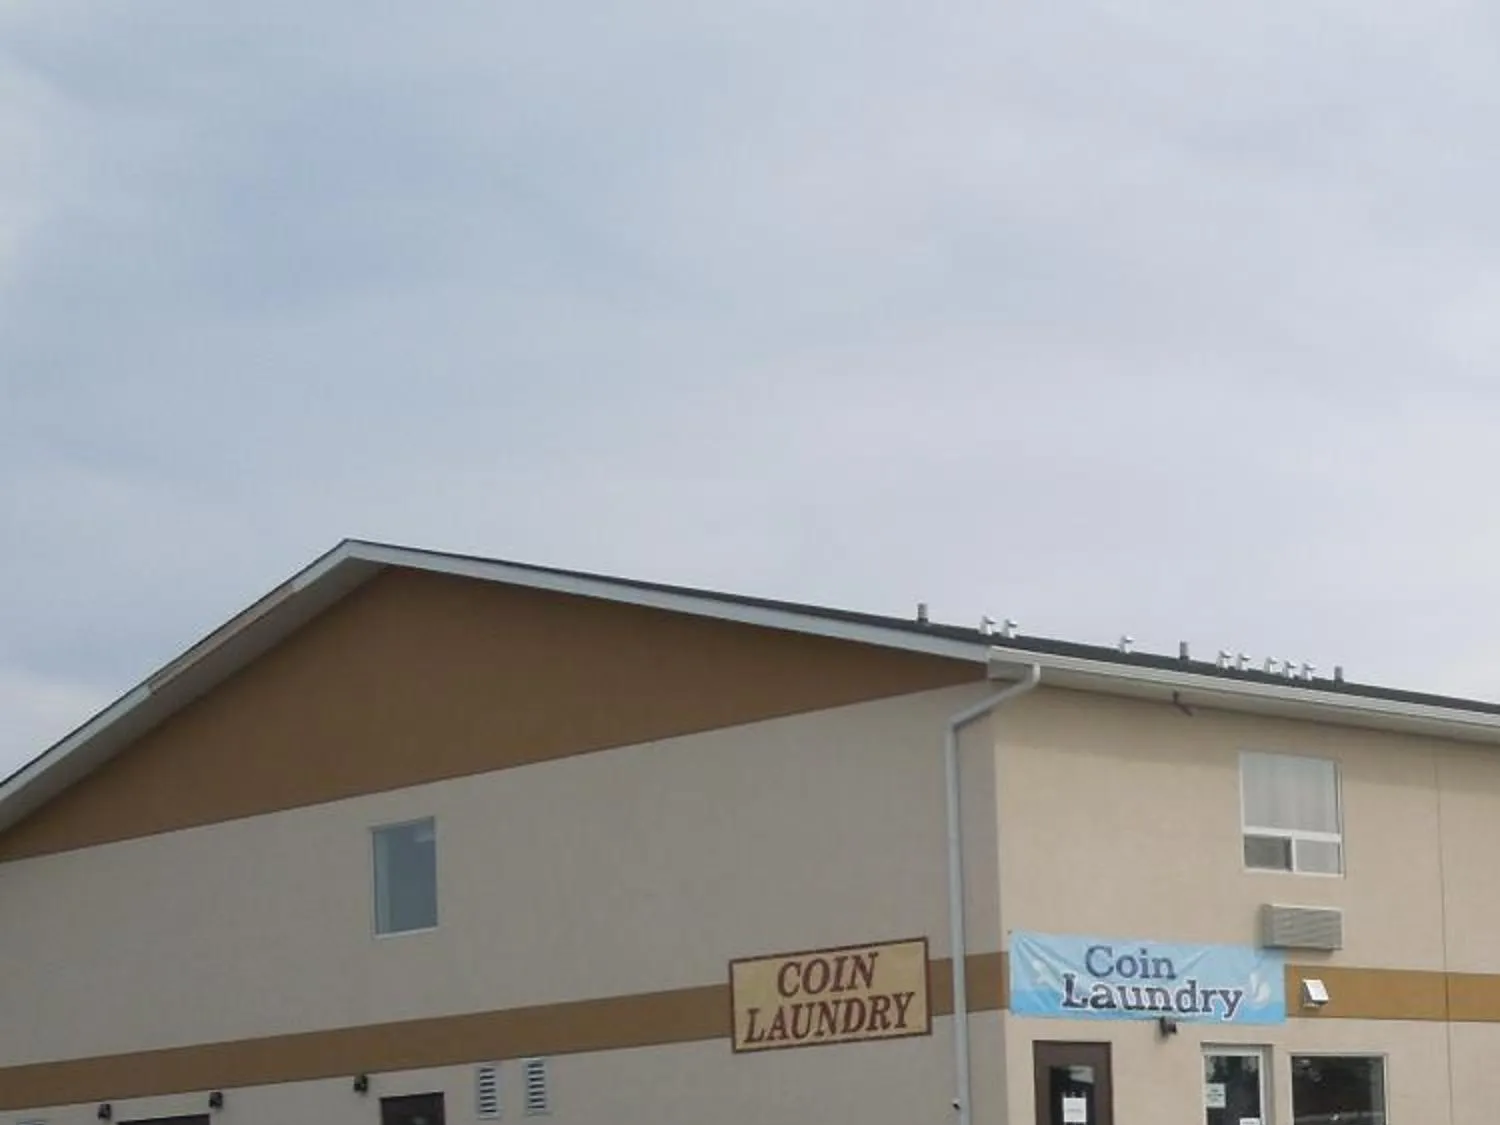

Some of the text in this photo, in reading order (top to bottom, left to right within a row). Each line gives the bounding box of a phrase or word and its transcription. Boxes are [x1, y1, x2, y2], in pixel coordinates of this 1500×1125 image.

[777, 952, 879, 997] COIN
[1085, 945, 1177, 980] Coin
[744, 992, 916, 1043] LAUNDRY
[1061, 973, 1243, 1019] Laundry
